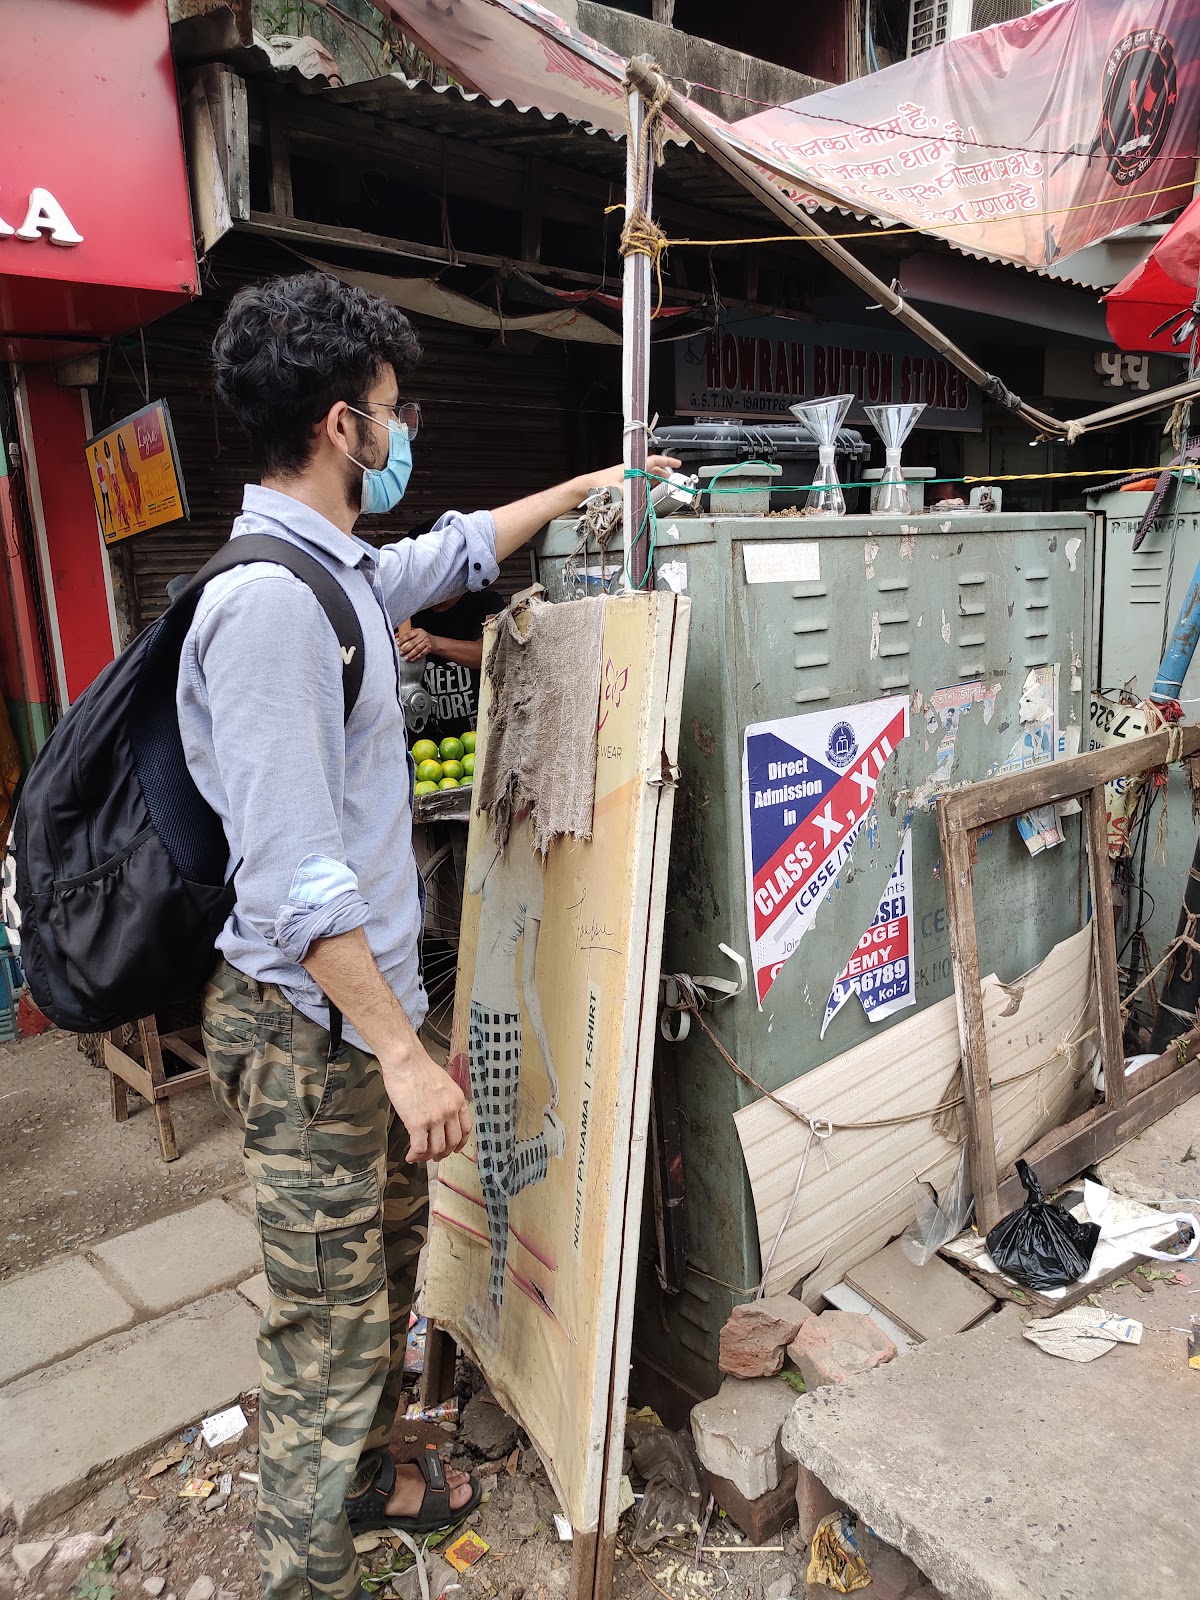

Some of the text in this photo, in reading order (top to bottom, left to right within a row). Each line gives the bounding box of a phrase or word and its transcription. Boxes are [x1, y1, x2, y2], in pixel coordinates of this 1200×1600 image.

[856, 116, 904, 144] नाम
[898, 136, 951, 169] धाम
[706, 331, 969, 412] HOWRAH BUTTON STORES
[424, 665, 472, 695] NEED
[600, 745, 622, 760] WEAR
[768, 757, 808, 781] Direct
[848, 735, 894, 806] XII
[754, 778, 823, 810] Admission
[783, 808, 797, 827] in
[795, 860, 837, 916] (CBSE
[884, 880, 906, 897] nts
[879, 981, 908, 1001] Kol-7
[585, 990, 597, 1069] T-SHIRT
[576, 1100, 590, 1183] PYJAMA
[573, 1186, 584, 1251] NIGHT
